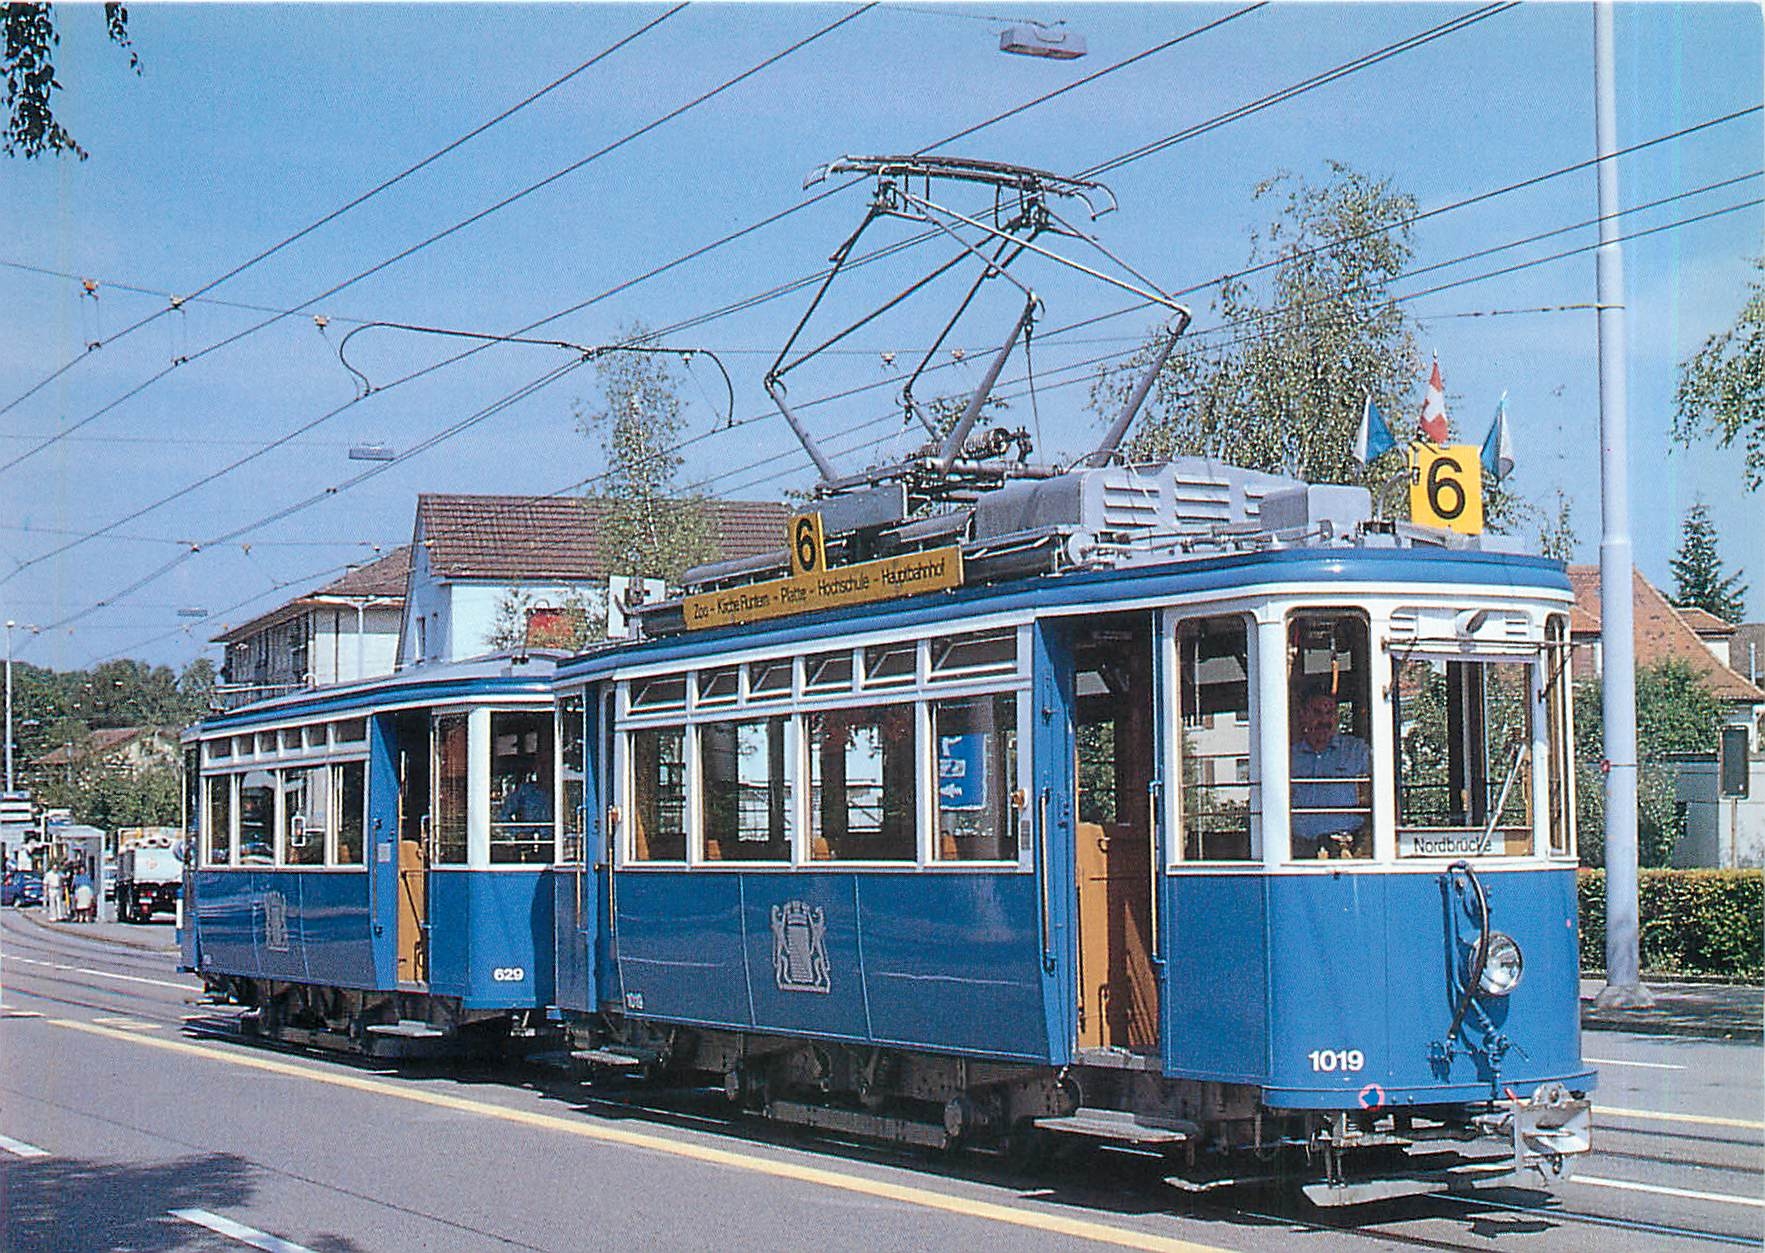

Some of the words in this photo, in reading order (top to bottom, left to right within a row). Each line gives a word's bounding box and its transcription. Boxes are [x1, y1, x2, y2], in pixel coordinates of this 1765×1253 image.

[1427, 456, 1466, 520] 6
[795, 517, 817, 572] 6
[694, 603, 709, 620] Zoo
[818, 572, 870, 597] Hochschule
[881, 557, 946, 587] Hauptbahnhof
[1413, 836, 1492, 853] Nordbrücke
[493, 967, 525, 982] 629
[1307, 1049, 1365, 1073] 1019
